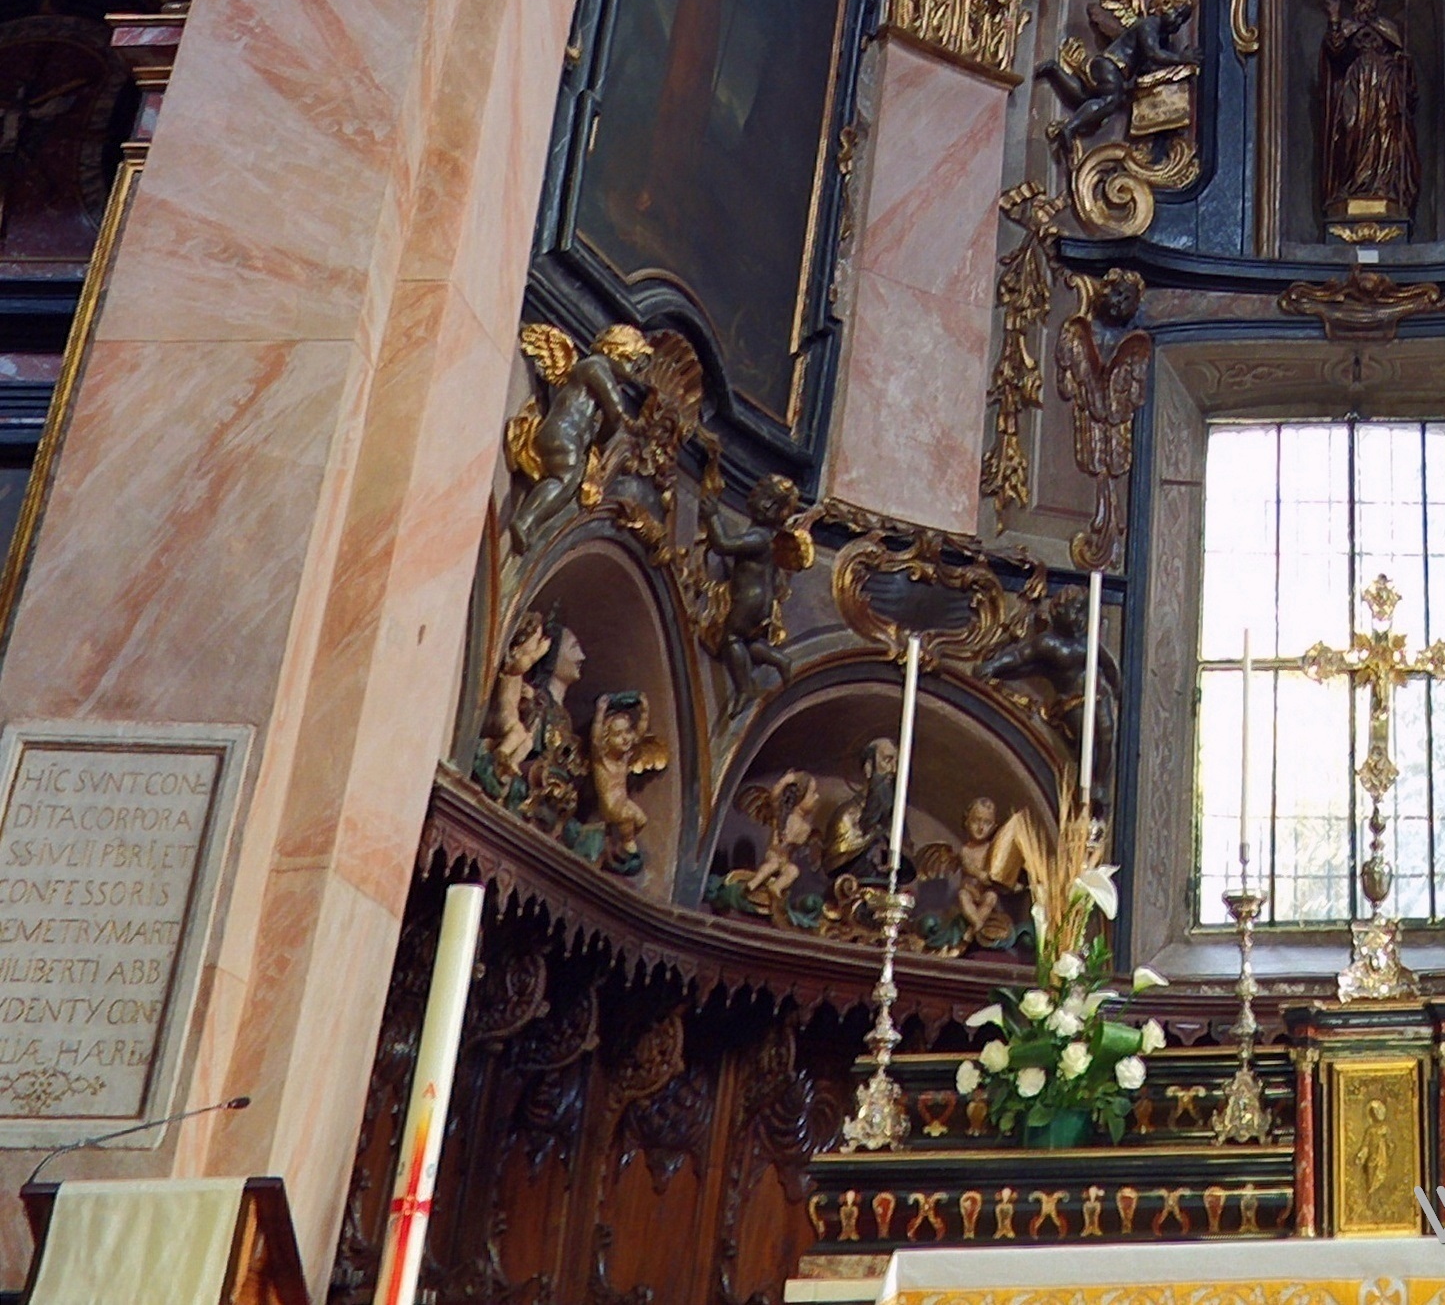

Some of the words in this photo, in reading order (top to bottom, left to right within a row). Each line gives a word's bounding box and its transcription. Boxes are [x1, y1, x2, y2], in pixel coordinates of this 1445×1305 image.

[21, 763, 71, 792] HIC
[73, 768, 144, 795] SVNT
[13, 798, 77, 830] DITA
[80, 805, 193, 832] CORPORA
